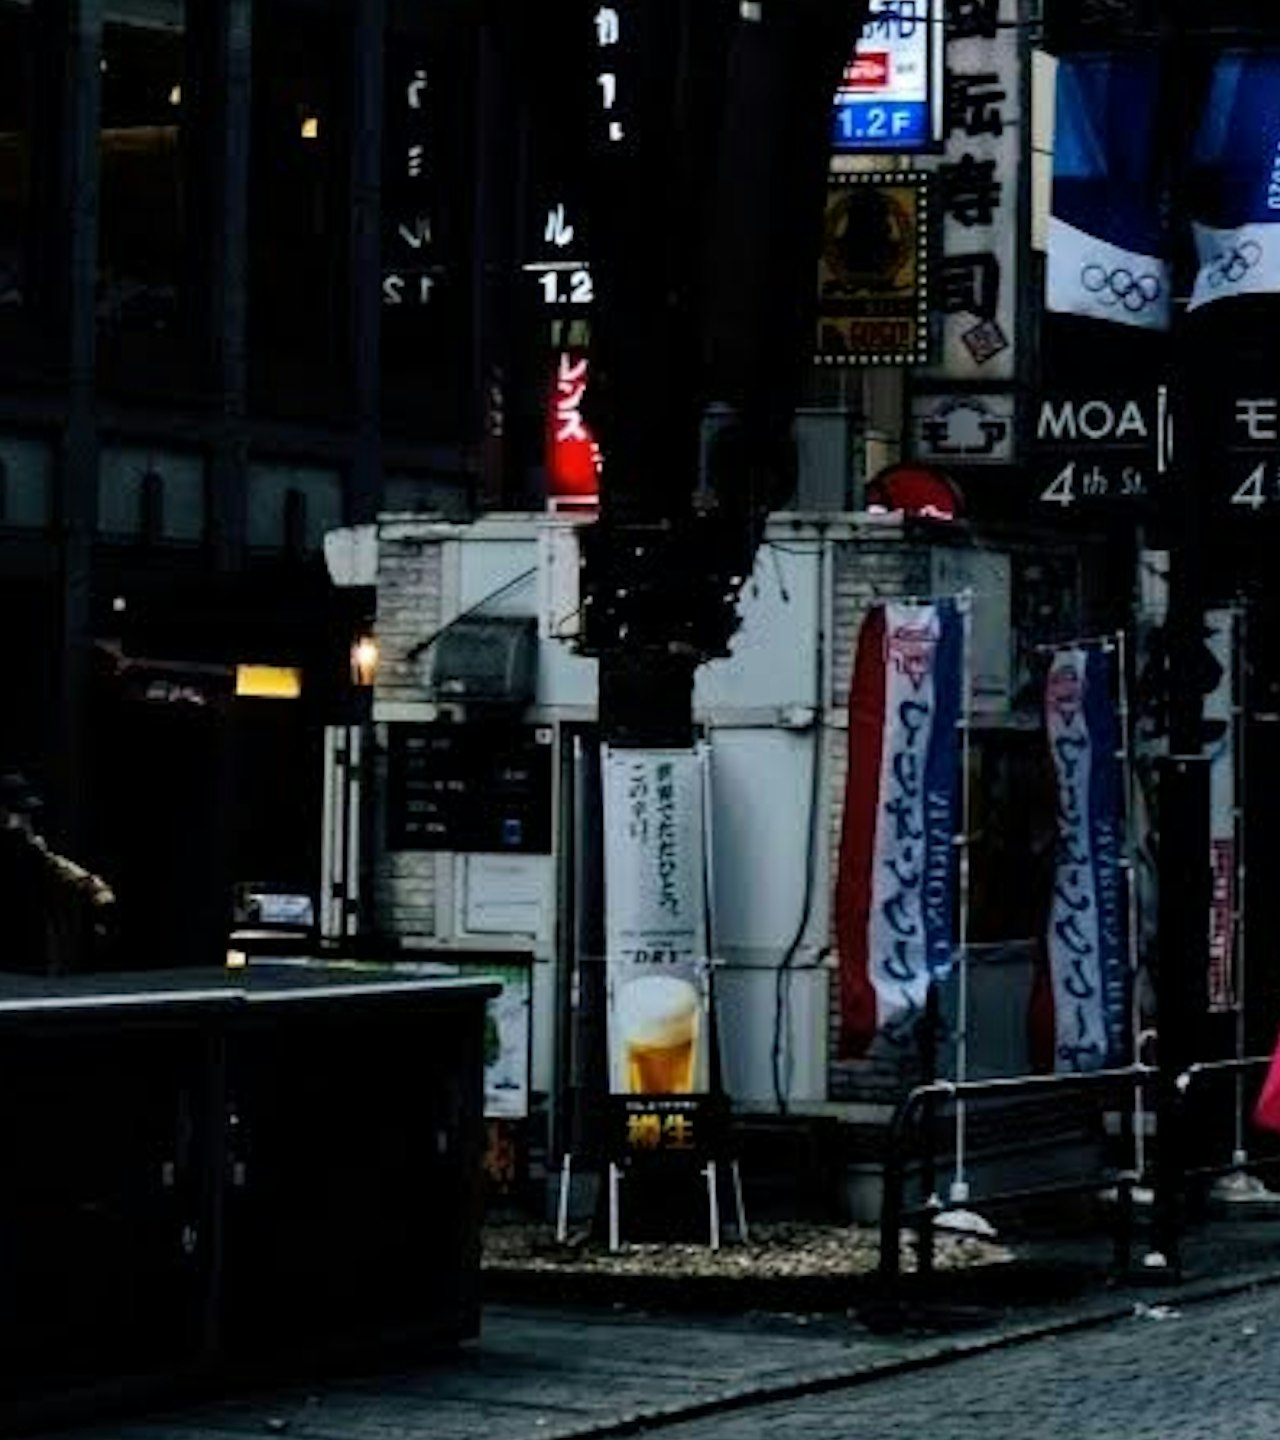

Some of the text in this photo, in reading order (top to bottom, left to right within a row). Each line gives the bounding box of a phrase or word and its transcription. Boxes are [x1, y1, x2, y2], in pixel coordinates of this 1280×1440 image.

[837, 108, 912, 138] 1.2F
[1036, 400, 1148, 440] MOA
[1038, 460, 1110, 509] 4th
